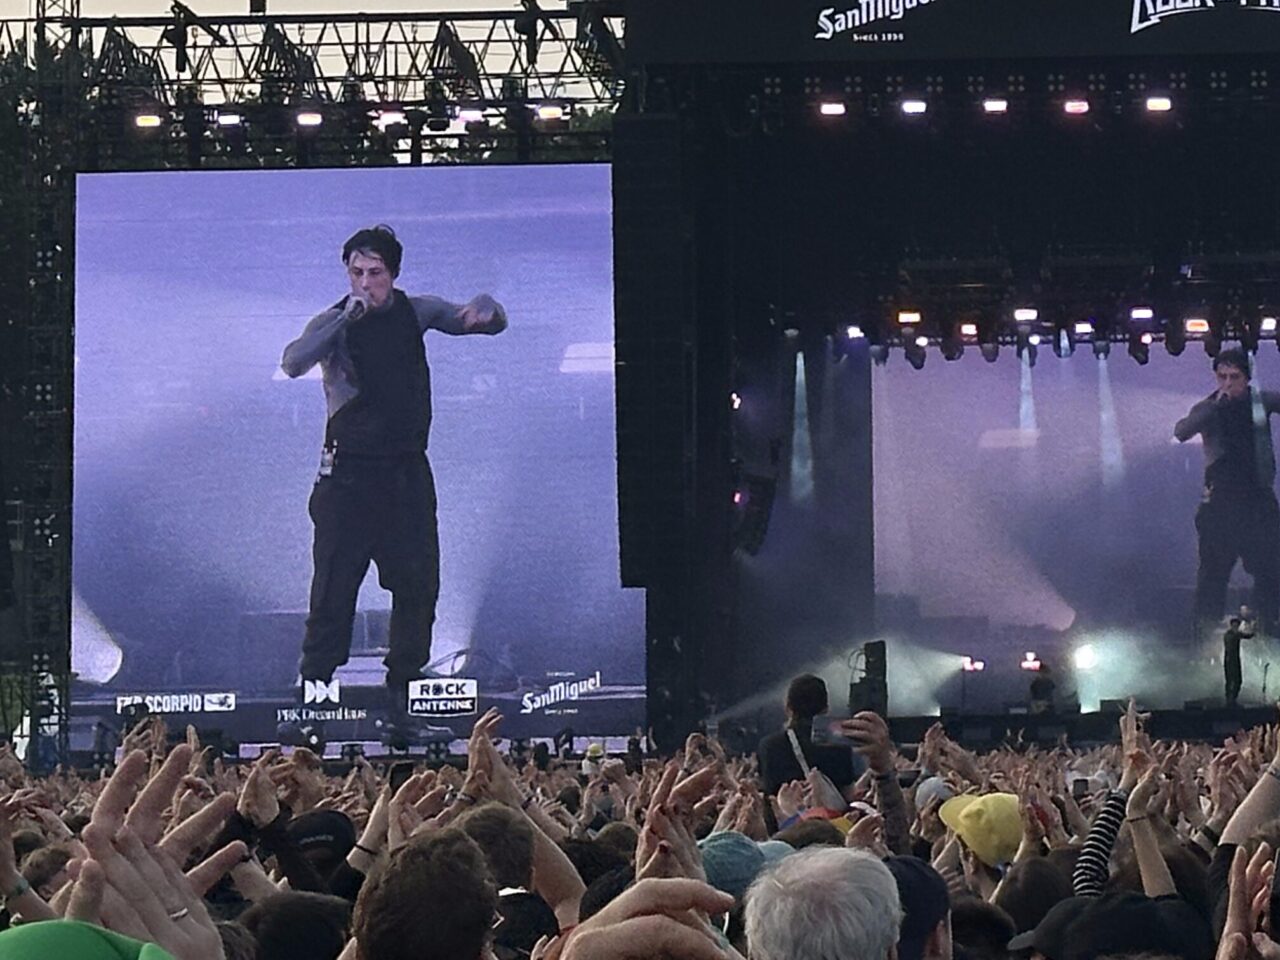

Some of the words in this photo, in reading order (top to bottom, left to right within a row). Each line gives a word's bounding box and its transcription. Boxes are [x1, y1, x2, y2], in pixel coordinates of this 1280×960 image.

[420, 683, 467, 696] ROCK
[144, 694, 202, 713] SCORPIO
[412, 700, 473, 711] ANTENNE
